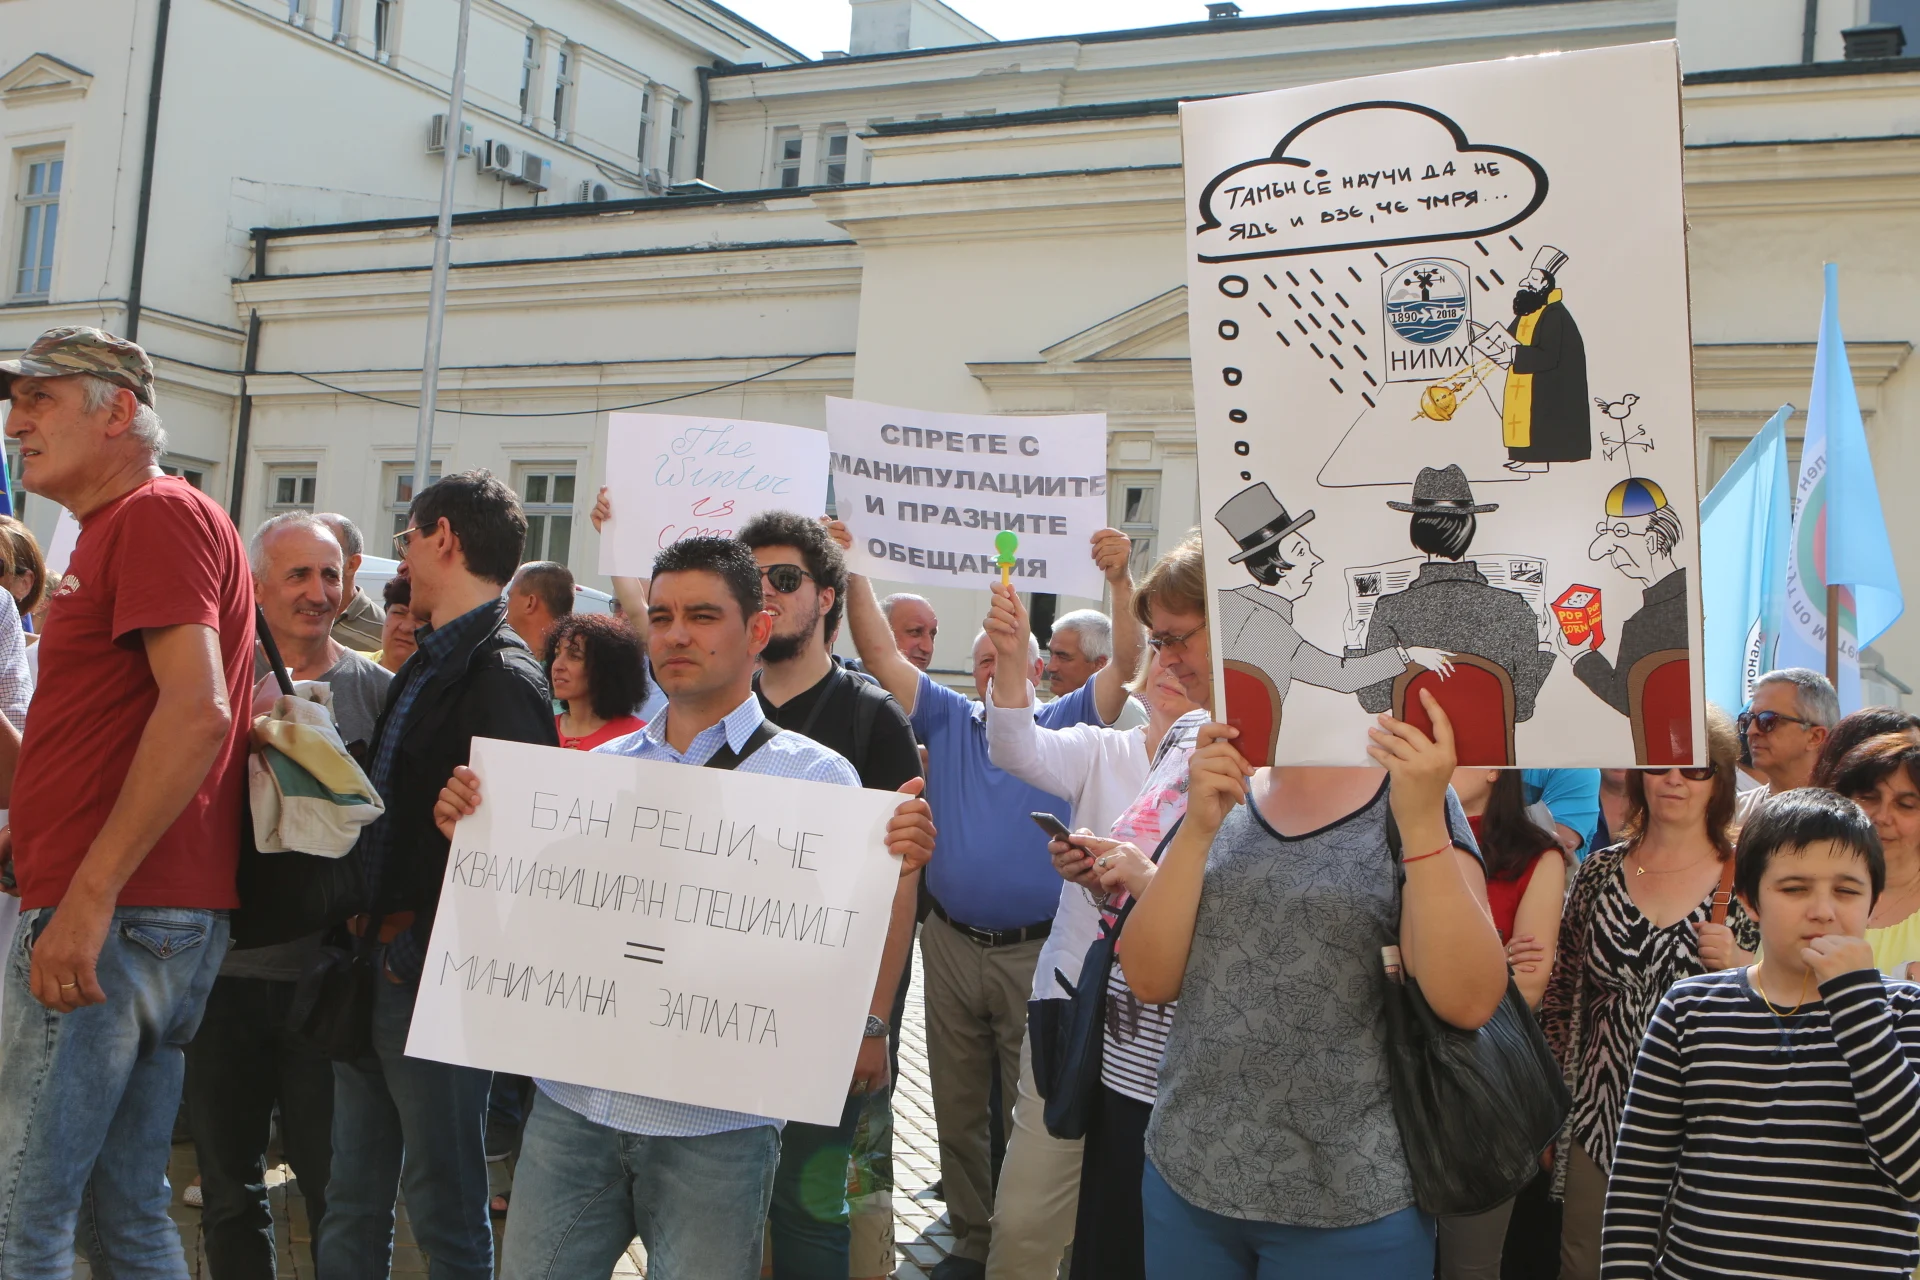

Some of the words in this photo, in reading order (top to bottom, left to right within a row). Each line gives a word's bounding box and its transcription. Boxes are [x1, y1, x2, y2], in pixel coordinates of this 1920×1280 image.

[1341, 166, 1412, 190] НАУЧИ
[1419, 160, 1456, 180] ДА
[1474, 161, 1500, 177] НЕ
[1228, 221, 1277, 241] ЯДЕ
[1290, 215, 1304, 228] И
[1377, 201, 1409, 215] ЧЕ
[1391, 312, 1418, 323] 1890
[1436, 308, 1457, 319] 2018
[1391, 345, 1470, 372] НИМХ
[671, 425, 756, 458] The
[880, 423, 1009, 454] СПРЕТЕ
[1017, 435, 1041, 457] С
[655, 453, 792, 494] Winter
[829, 451, 1107, 498] МАНИПУЛАЦИИТЕ
[864, 494, 885, 516] И
[898, 501, 1068, 536] ПРАЗНИТЕ
[1558, 611, 1583, 621] POP
[1563, 624, 1589, 635] CORN
[531, 791, 614, 839] БАН
[631, 806, 759, 866] РЕШИ,
[777, 827, 824, 872] ЧЕ
[452, 848, 668, 919] КВАЛИФИЦИРАН
[674, 885, 860, 948] СПЕЦИАЛИСТ
[440, 951, 617, 1018] МИНИМАЛНА
[649, 987, 779, 1048] ЗАПЛАТА
